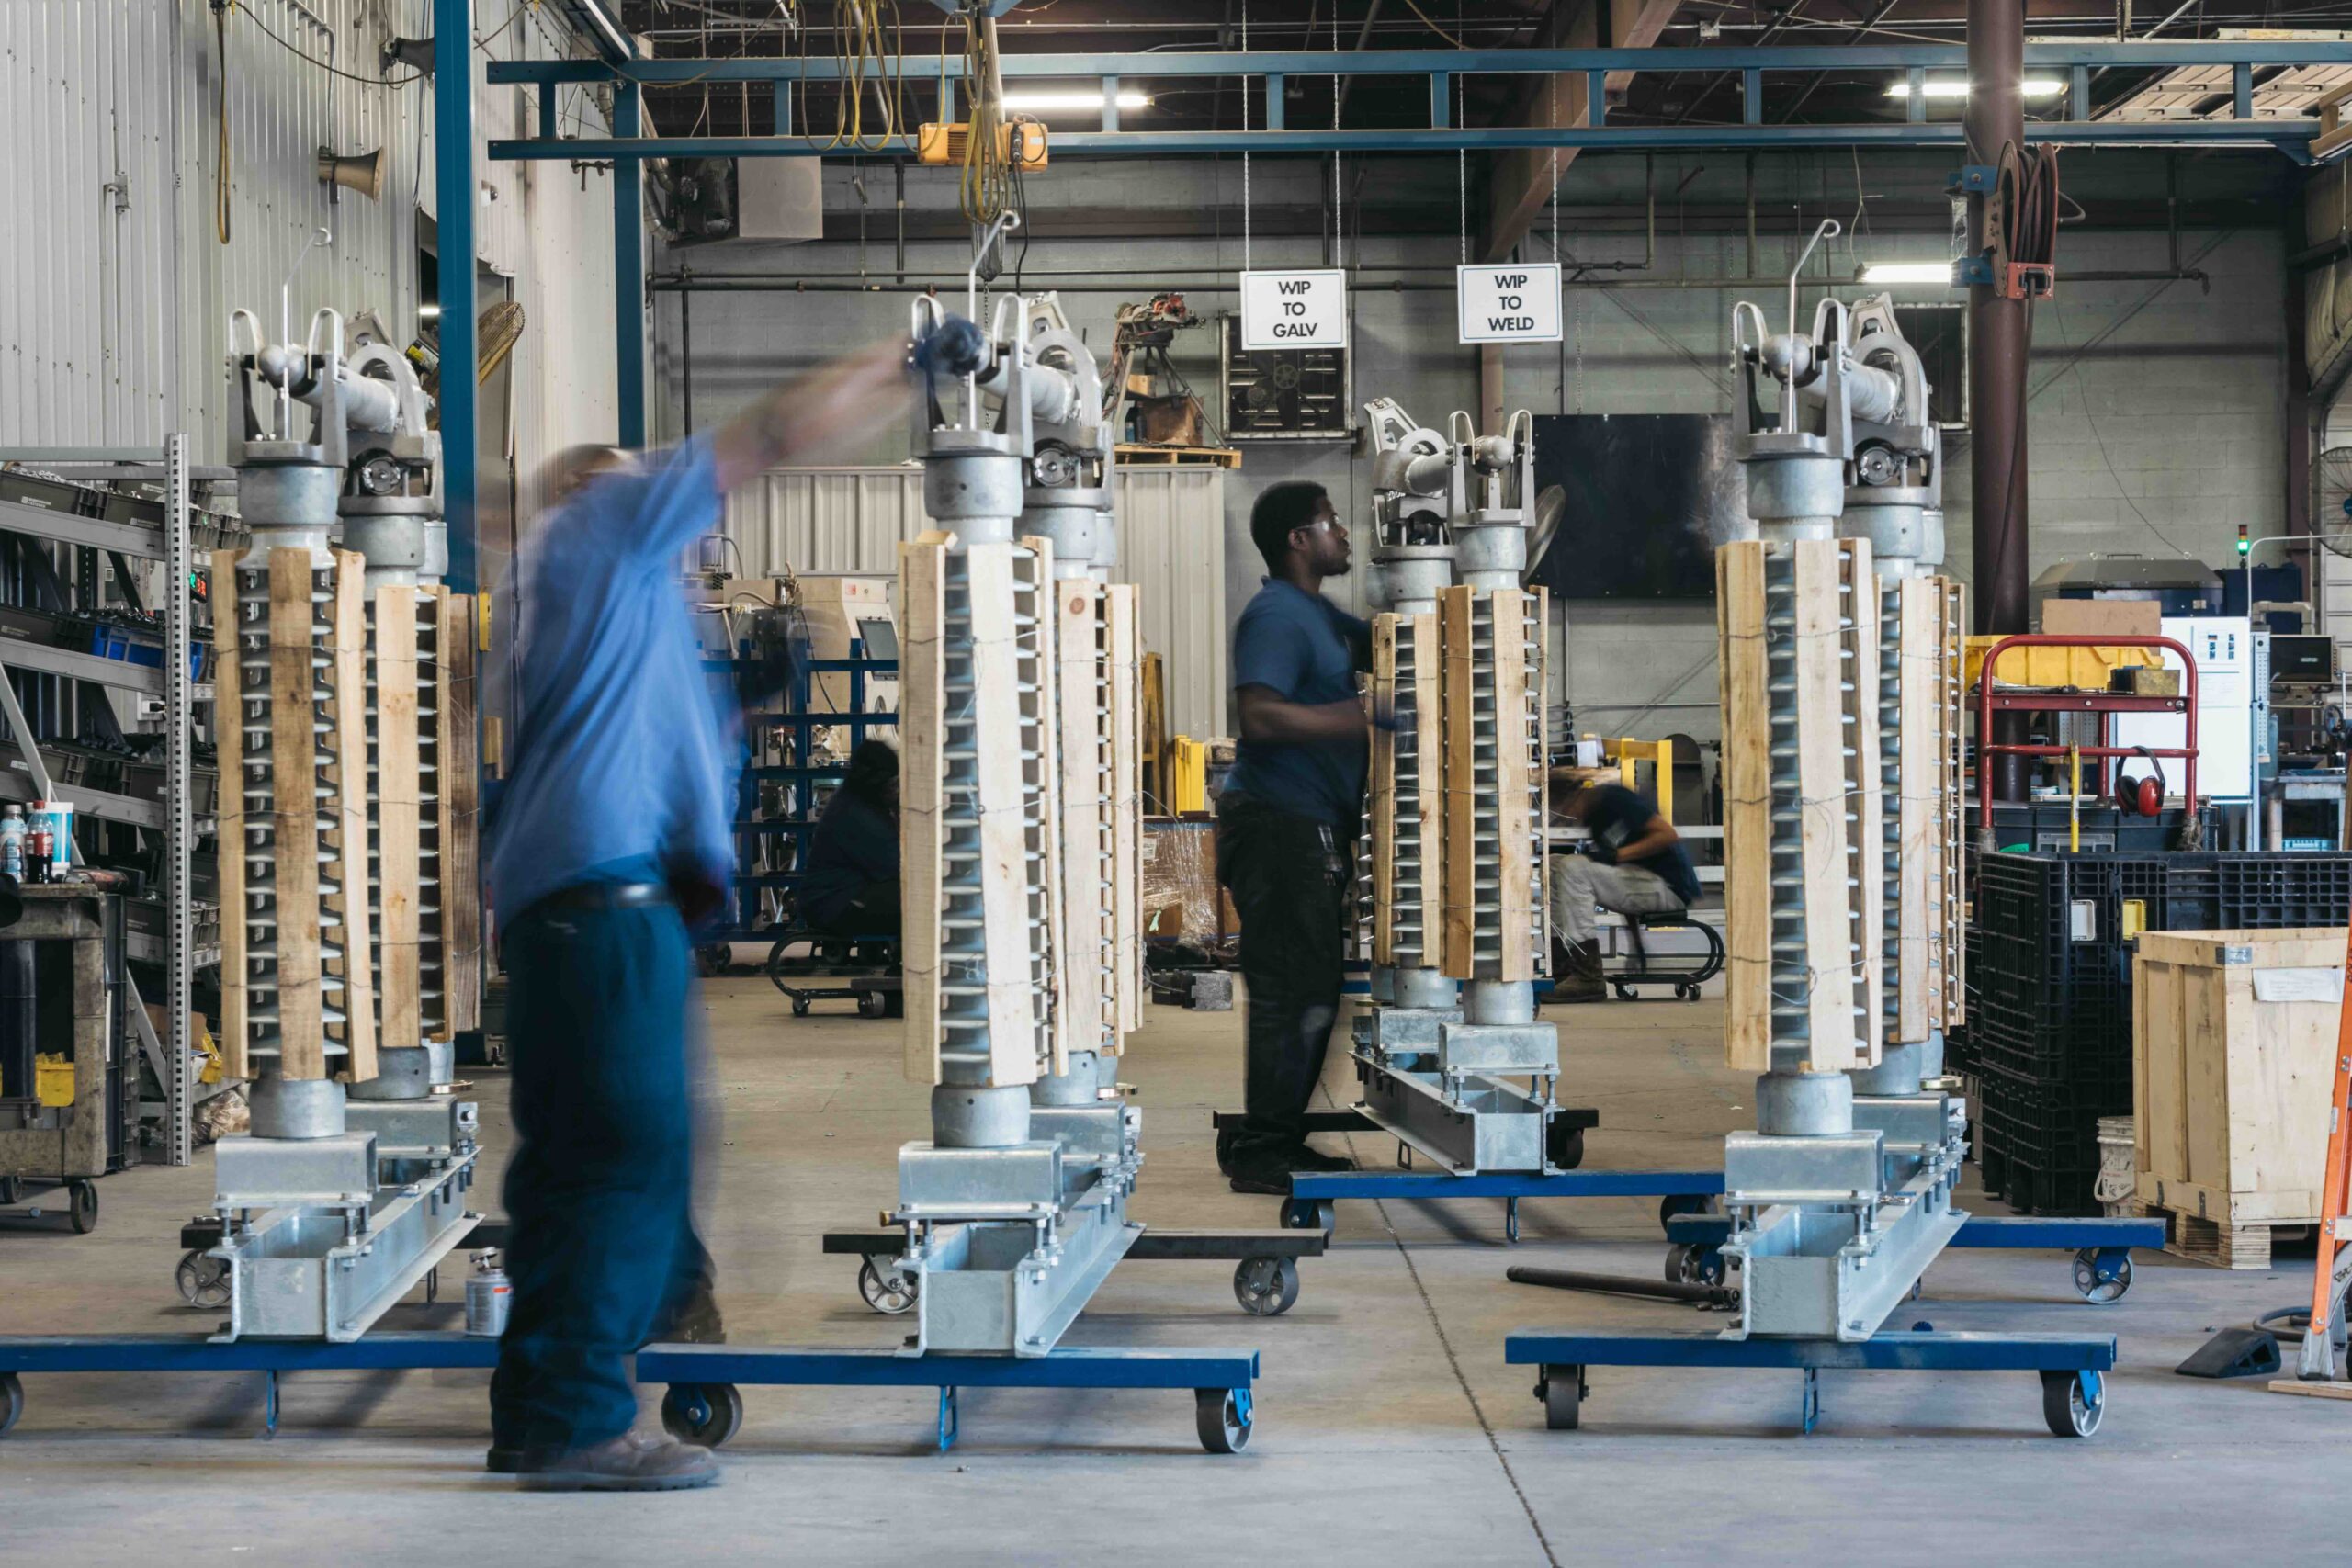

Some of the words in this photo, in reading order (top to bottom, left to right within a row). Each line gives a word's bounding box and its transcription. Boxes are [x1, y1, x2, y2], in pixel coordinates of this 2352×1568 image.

[1278, 280, 1311, 295] WIP
[1494, 274, 1528, 289] WIP
[1283, 301, 1306, 317] TO
[1498, 295, 1522, 310] TO
[1272, 322, 1317, 338] GALV
[1487, 316, 1534, 332] WELD
